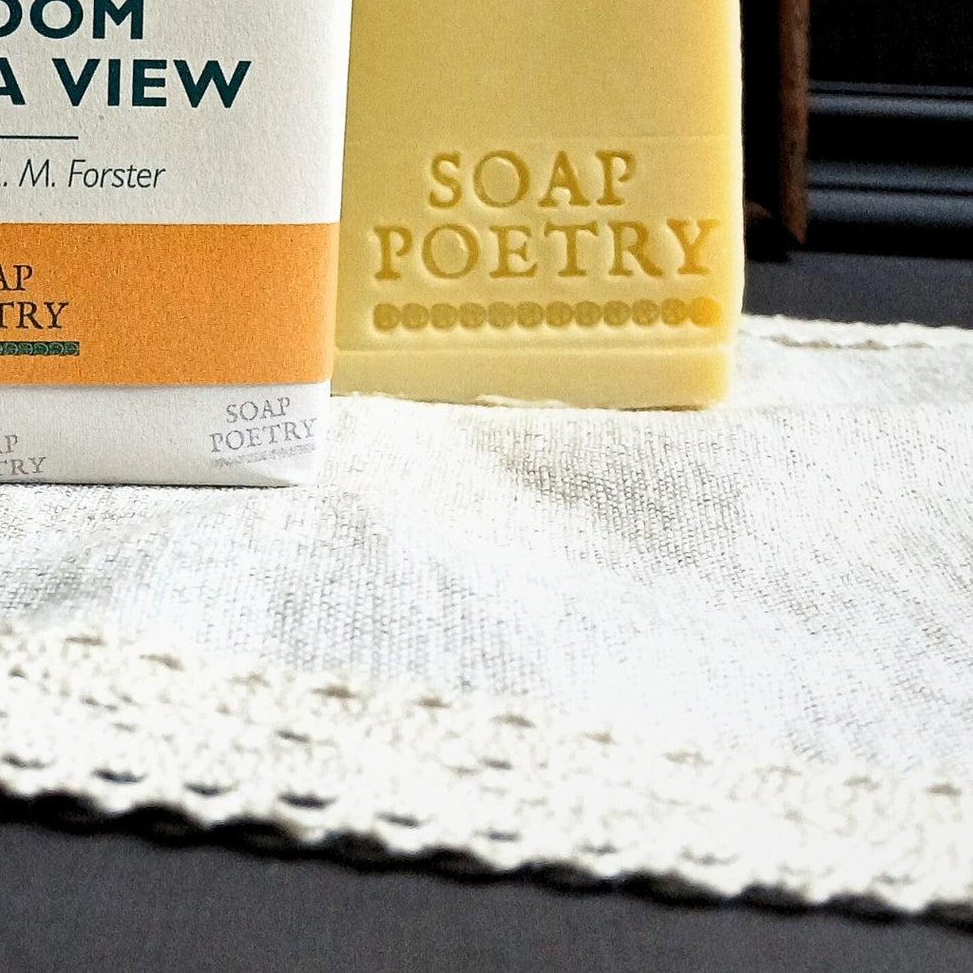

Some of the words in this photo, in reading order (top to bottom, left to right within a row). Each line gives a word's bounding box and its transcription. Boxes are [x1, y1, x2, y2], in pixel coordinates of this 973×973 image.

[51, 57, 252, 109] VIEW
[18, 158, 58, 188] M.
[67, 158, 167, 189] Forster
[429, 149, 636, 209] SOAP
[373, 218, 720, 280] POETRY
[226, 397, 291, 423] SOAP
[209, 417, 318, 453] POETRY
